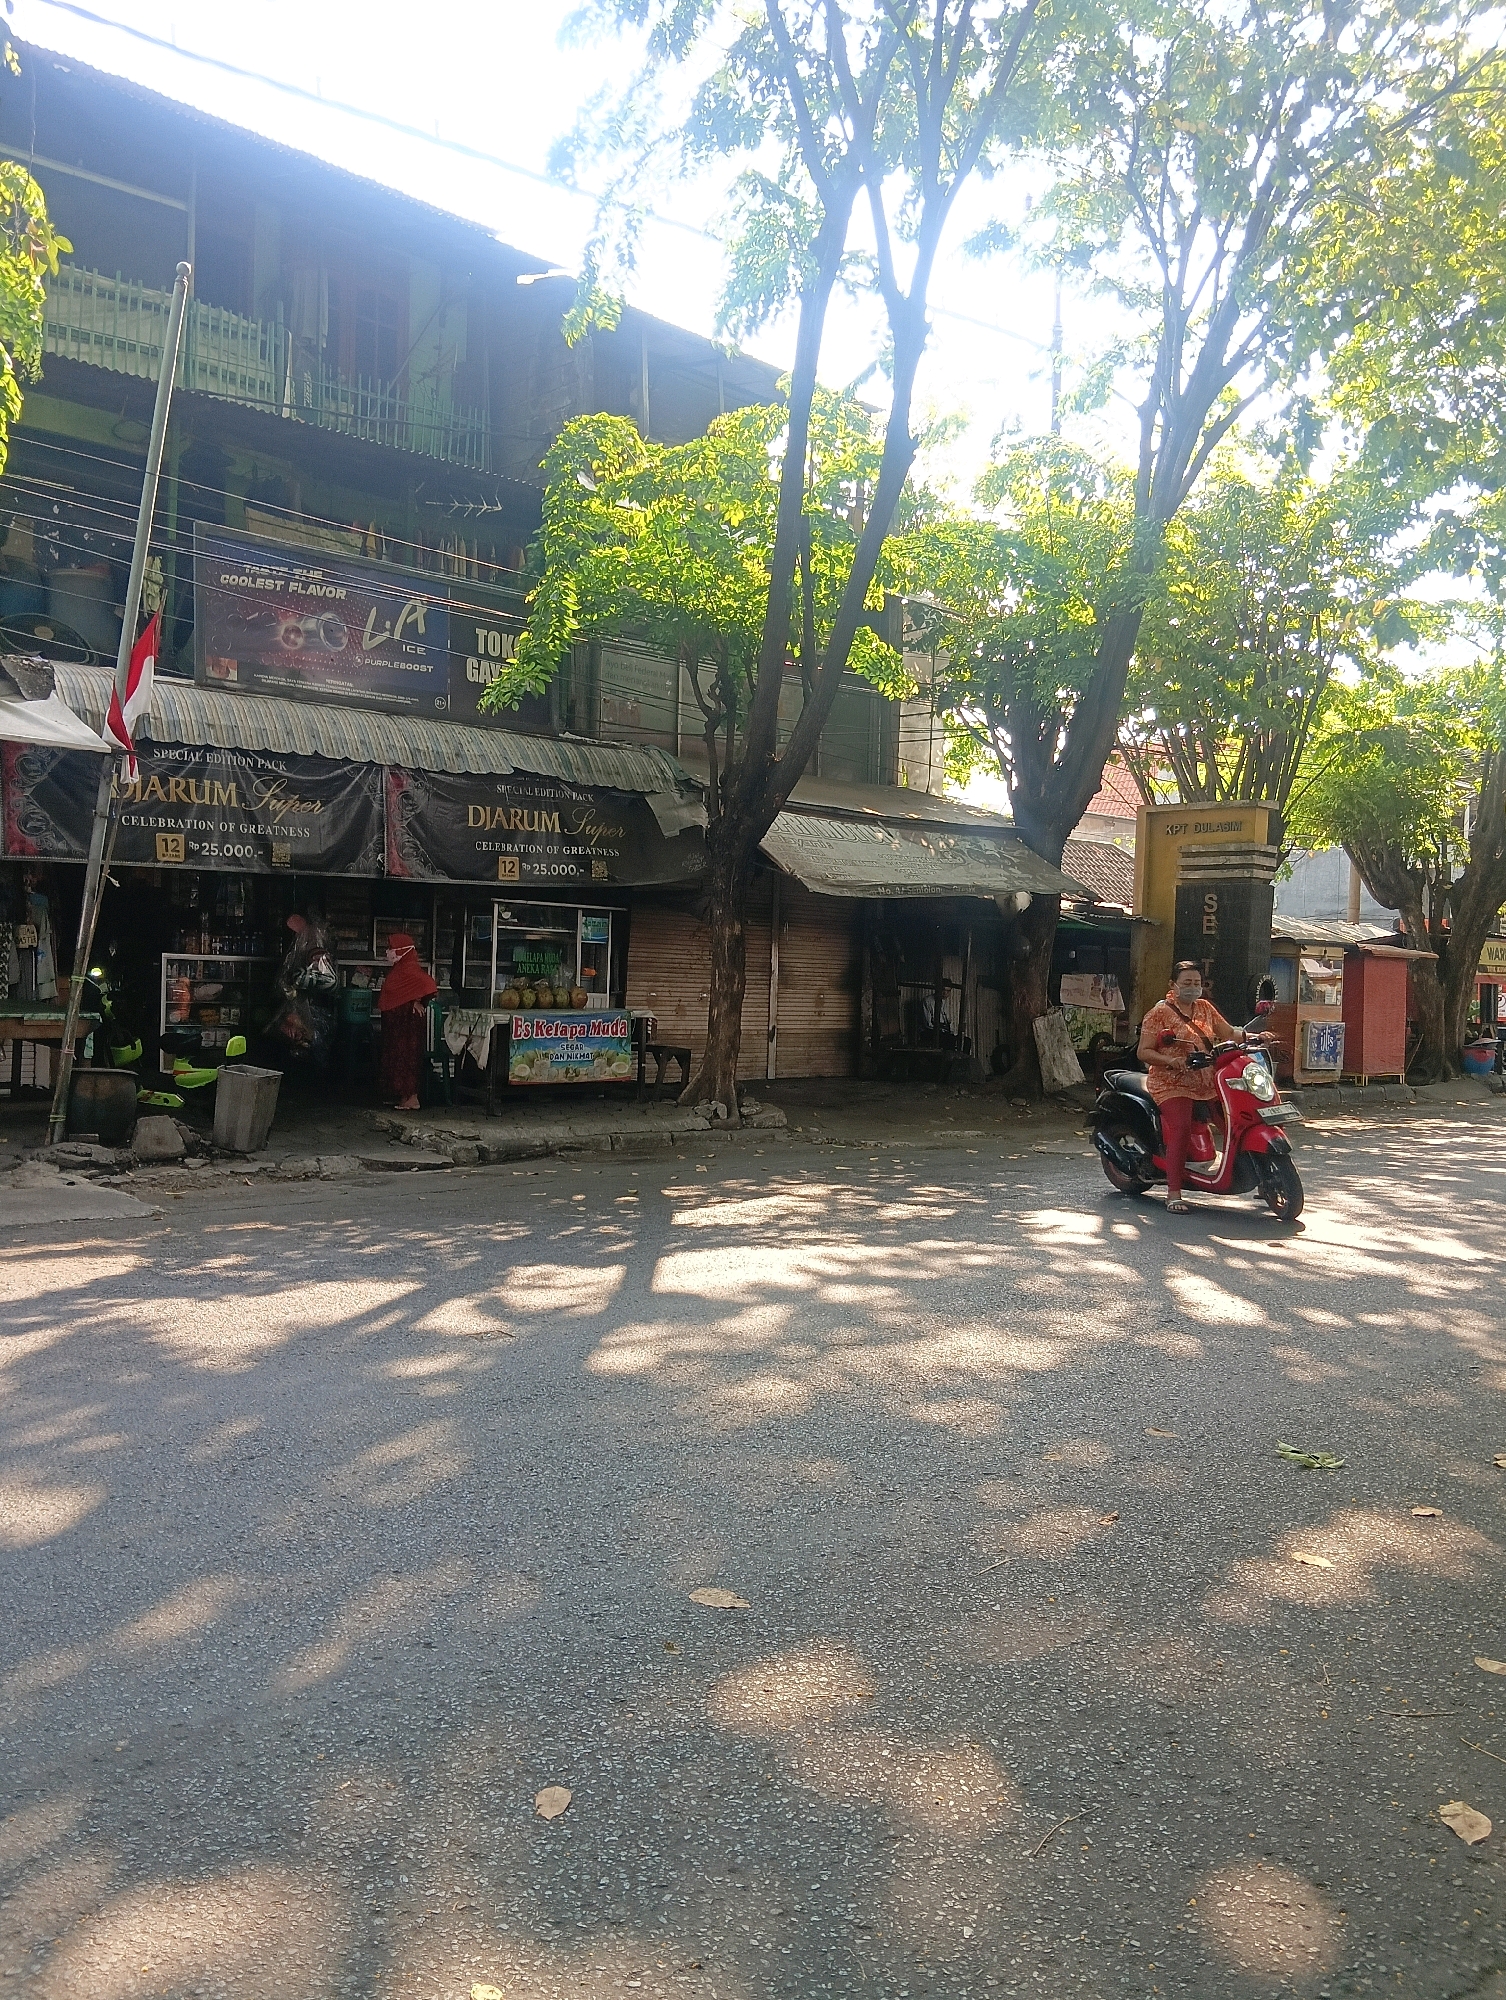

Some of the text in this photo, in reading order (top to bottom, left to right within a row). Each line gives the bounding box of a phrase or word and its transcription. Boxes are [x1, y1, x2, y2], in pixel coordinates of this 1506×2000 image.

[220, 574, 347, 600] COOLEST FLAVOR
[402, 644, 427, 655] ICE
[364, 658, 434, 673] PURPLEBOOST
[605, 659, 618, 669] Ayo
[635, 664, 659, 677] Federal
[153, 748, 287, 771] SPECIAL EDITION PACK
[242, 777, 325, 824] Super
[496, 784, 594, 802] SPECIAL EDITION PACK
[121, 815, 310, 838] CELEBRATION OF GREATNESS
[467, 804, 626, 846] DJARUM Super
[1165, 821, 1242, 835] KPT DULASIM
[161, 838, 181, 853] 12
[188, 841, 200, 852] Rp
[475, 841, 620, 857] CELEBRATION OF GREATNESS
[501, 860, 515, 873] 12
[521, 862, 531, 873] Rp
[1486, 946, 1506, 961] WAR
[517, 963, 540, 974] ANEKA
[512, 1015, 628, 1041] Es Kelapa Muda
[560, 1043, 584, 1051] SEGAR
[549, 1052, 594, 1061] DAN NIKMAT
